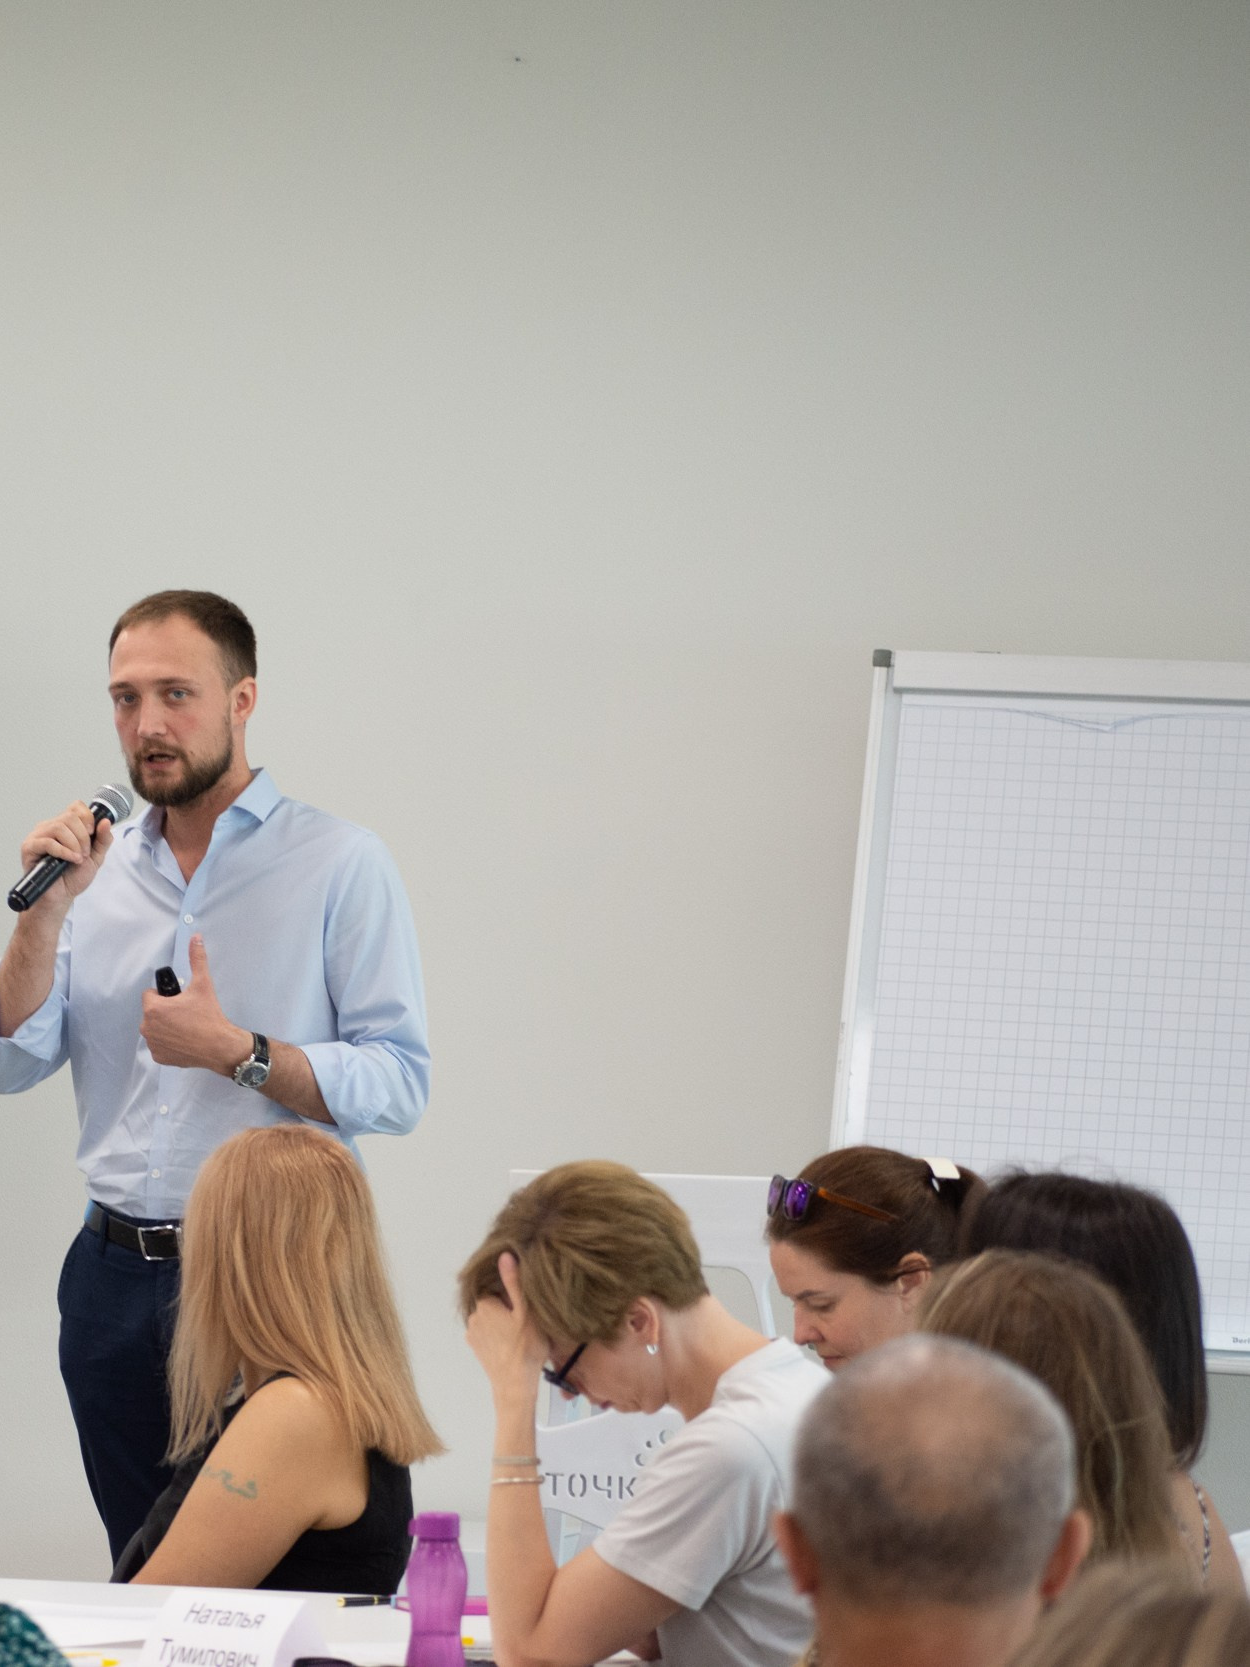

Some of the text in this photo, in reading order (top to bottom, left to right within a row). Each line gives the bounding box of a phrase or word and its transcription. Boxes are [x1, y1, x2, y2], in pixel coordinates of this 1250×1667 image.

[545, 1472, 638, 1499] ТОЧК
[183, 1602, 266, 1630] Наталья
[158, 1637, 260, 1667] Тумилович
